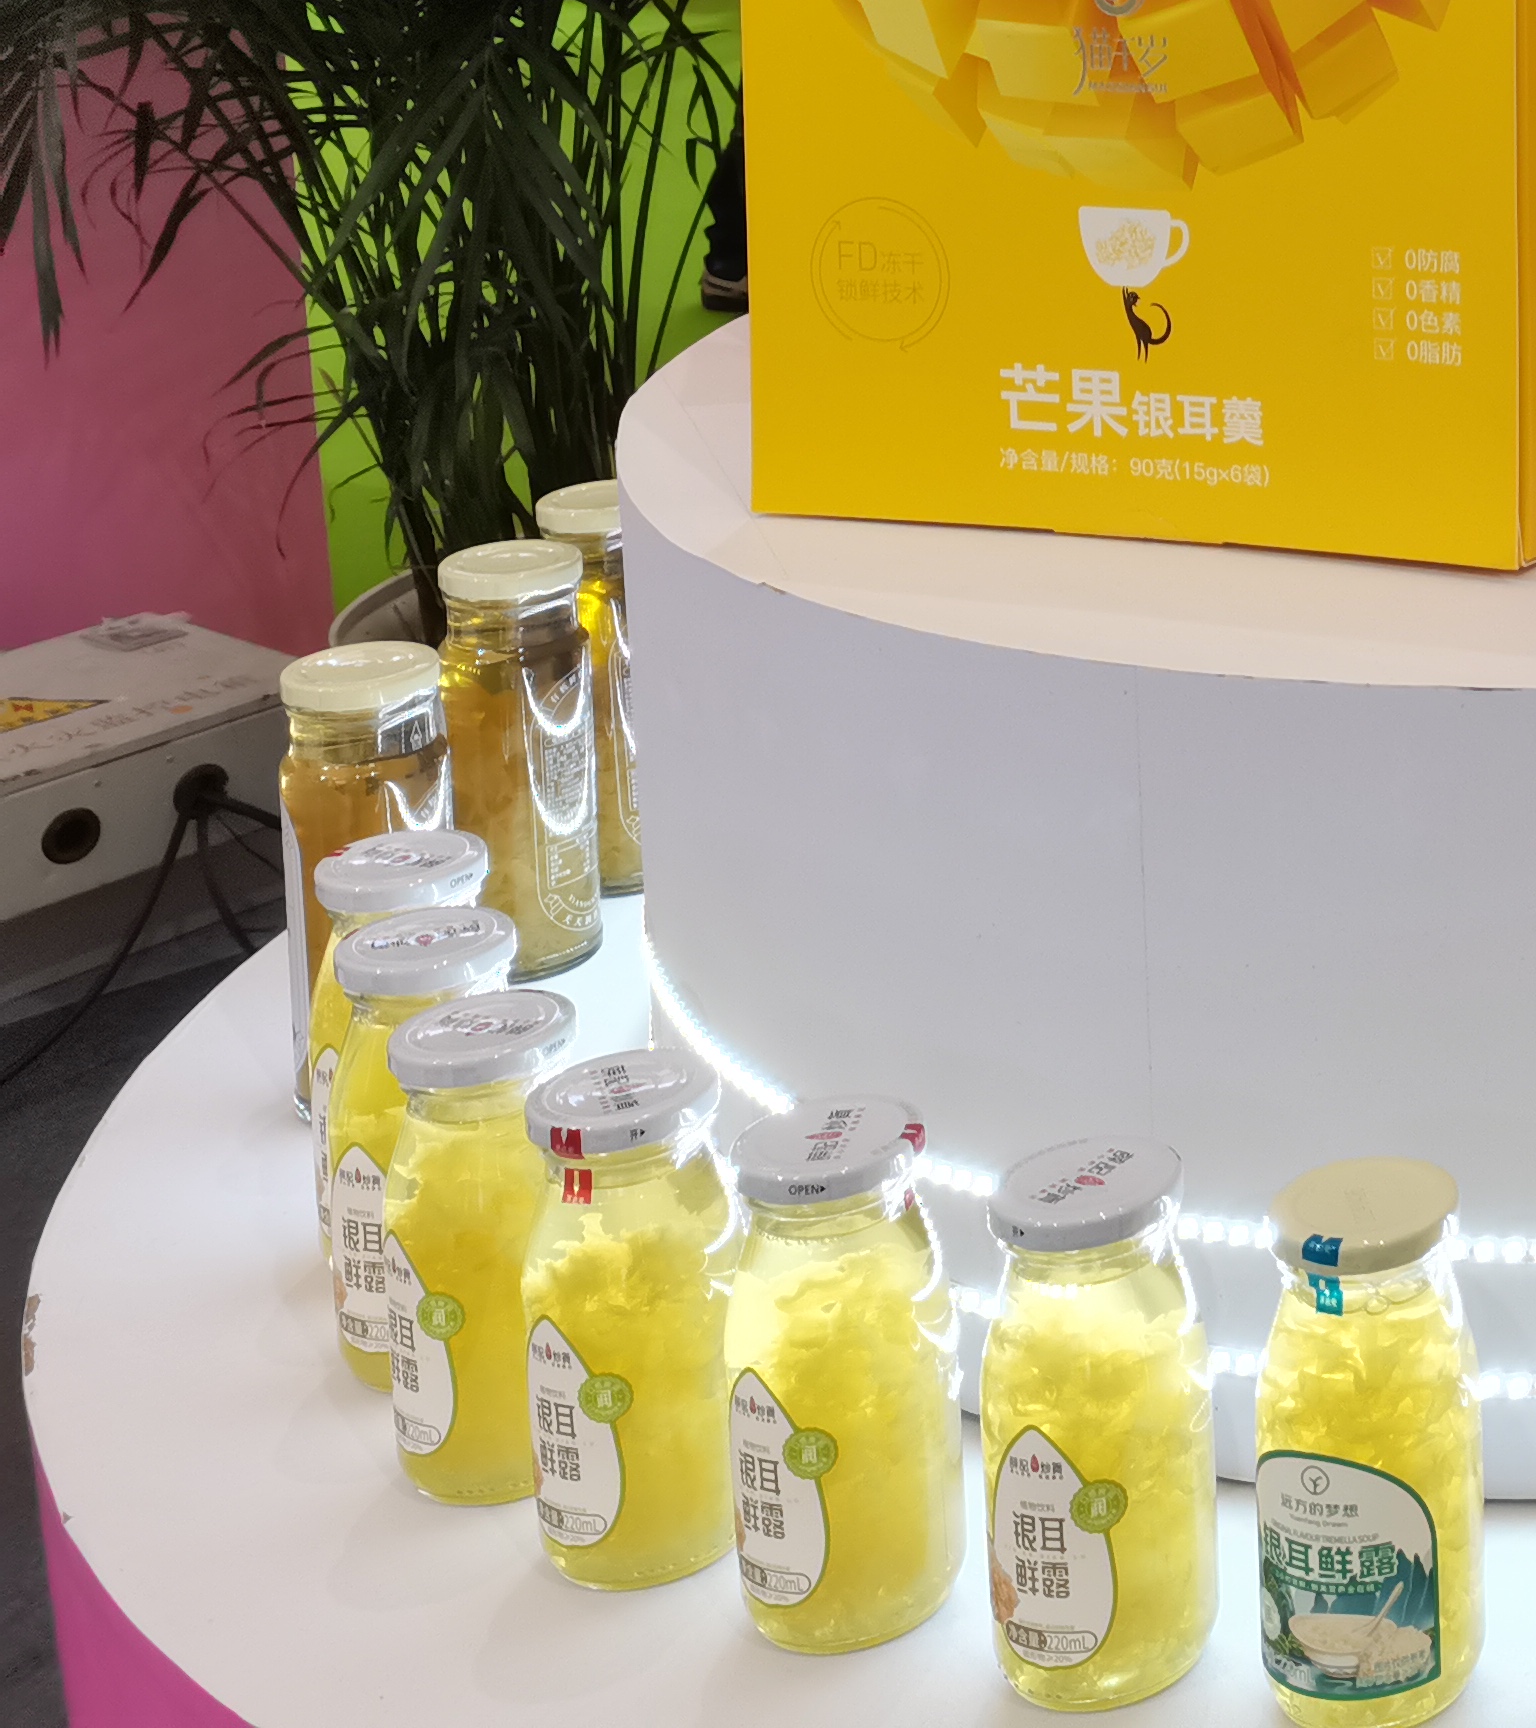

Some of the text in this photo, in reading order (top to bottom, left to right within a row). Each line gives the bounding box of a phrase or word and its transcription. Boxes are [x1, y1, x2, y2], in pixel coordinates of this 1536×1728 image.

[836, 279, 924, 305] 锁鲜技术
[788, 1183, 820, 1196] OPEN
[341, 1216, 384, 1254] 银耳
[536, 1394, 577, 1440] 银耳
[540, 1437, 581, 1482] 鲜露
[739, 1449, 781, 1496] 银耳
[564, 1513, 600, 1532] 220mL
[742, 1492, 786, 1540] 鲜露
[1280, 1492, 1359, 1518] 远方的梦想
[1012, 1511, 1067, 1554] 银耳
[1263, 1520, 1397, 1579] 银耳鲜露
[767, 1573, 804, 1592] 220mL
[1015, 1555, 1071, 1599] 鲜露
[1047, 1633, 1089, 1652] 220mL
